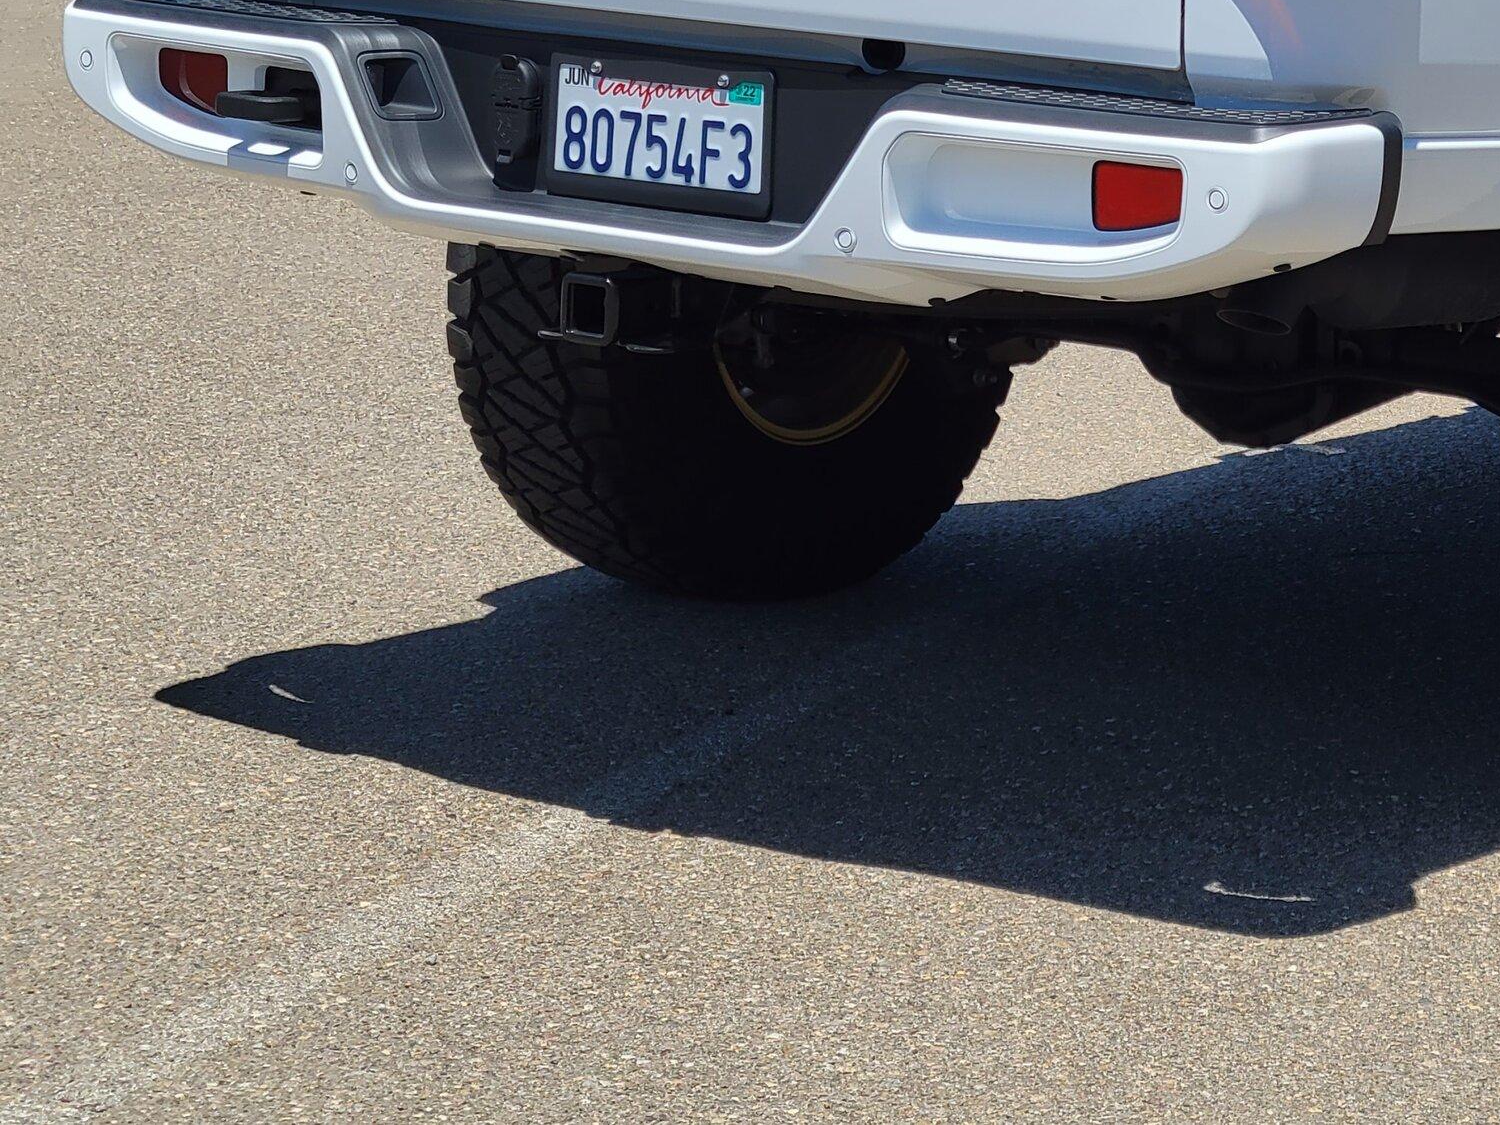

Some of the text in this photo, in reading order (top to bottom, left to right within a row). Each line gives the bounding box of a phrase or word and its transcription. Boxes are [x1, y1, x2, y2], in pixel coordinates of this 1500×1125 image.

[565, 66, 590, 86] JUN
[596, 76, 729, 109] California
[743, 85, 755, 97] 22
[563, 105, 753, 189] 80754F3
